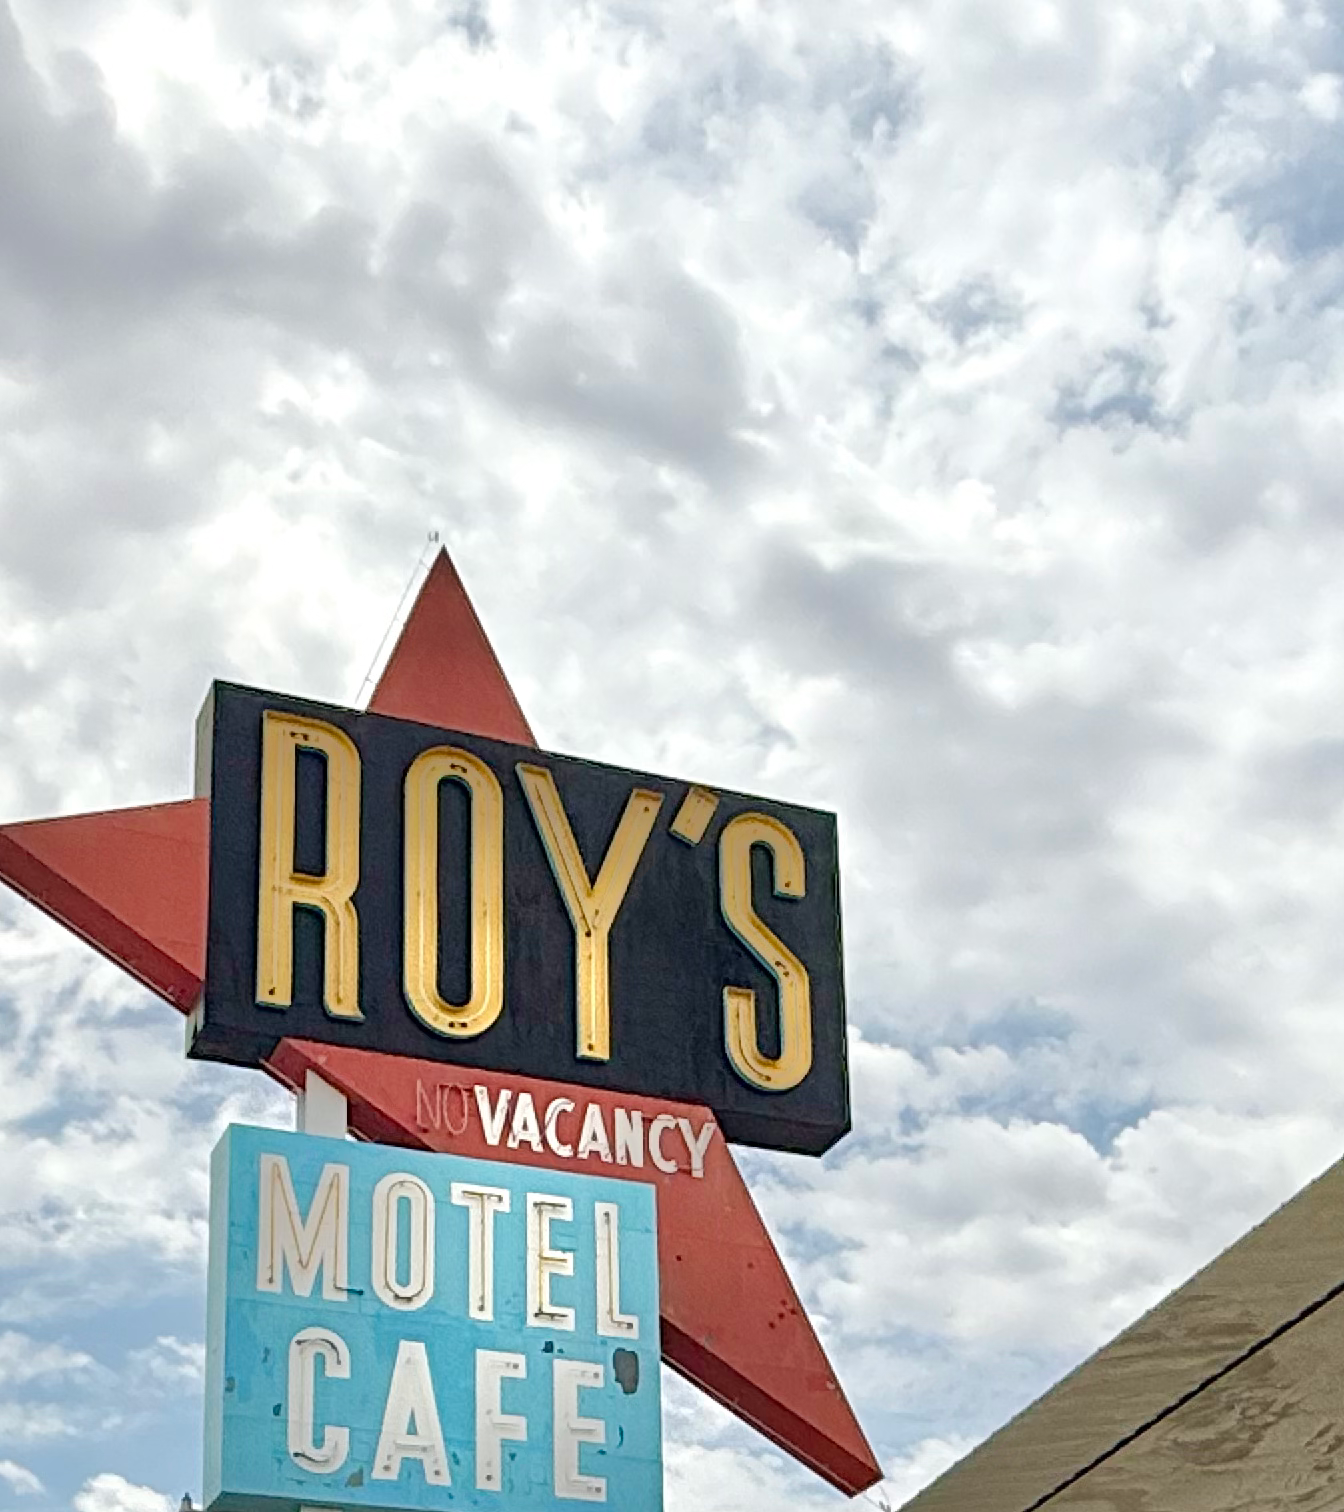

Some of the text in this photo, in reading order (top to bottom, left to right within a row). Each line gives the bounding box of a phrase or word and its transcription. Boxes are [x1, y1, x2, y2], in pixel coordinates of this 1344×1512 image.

[256, 708, 813, 1093] ROY'S
[416, 1079, 720, 1179] NO VACANCY
[256, 1152, 640, 1340] MOTEL
[286, 1326, 608, 1502] CAFE
